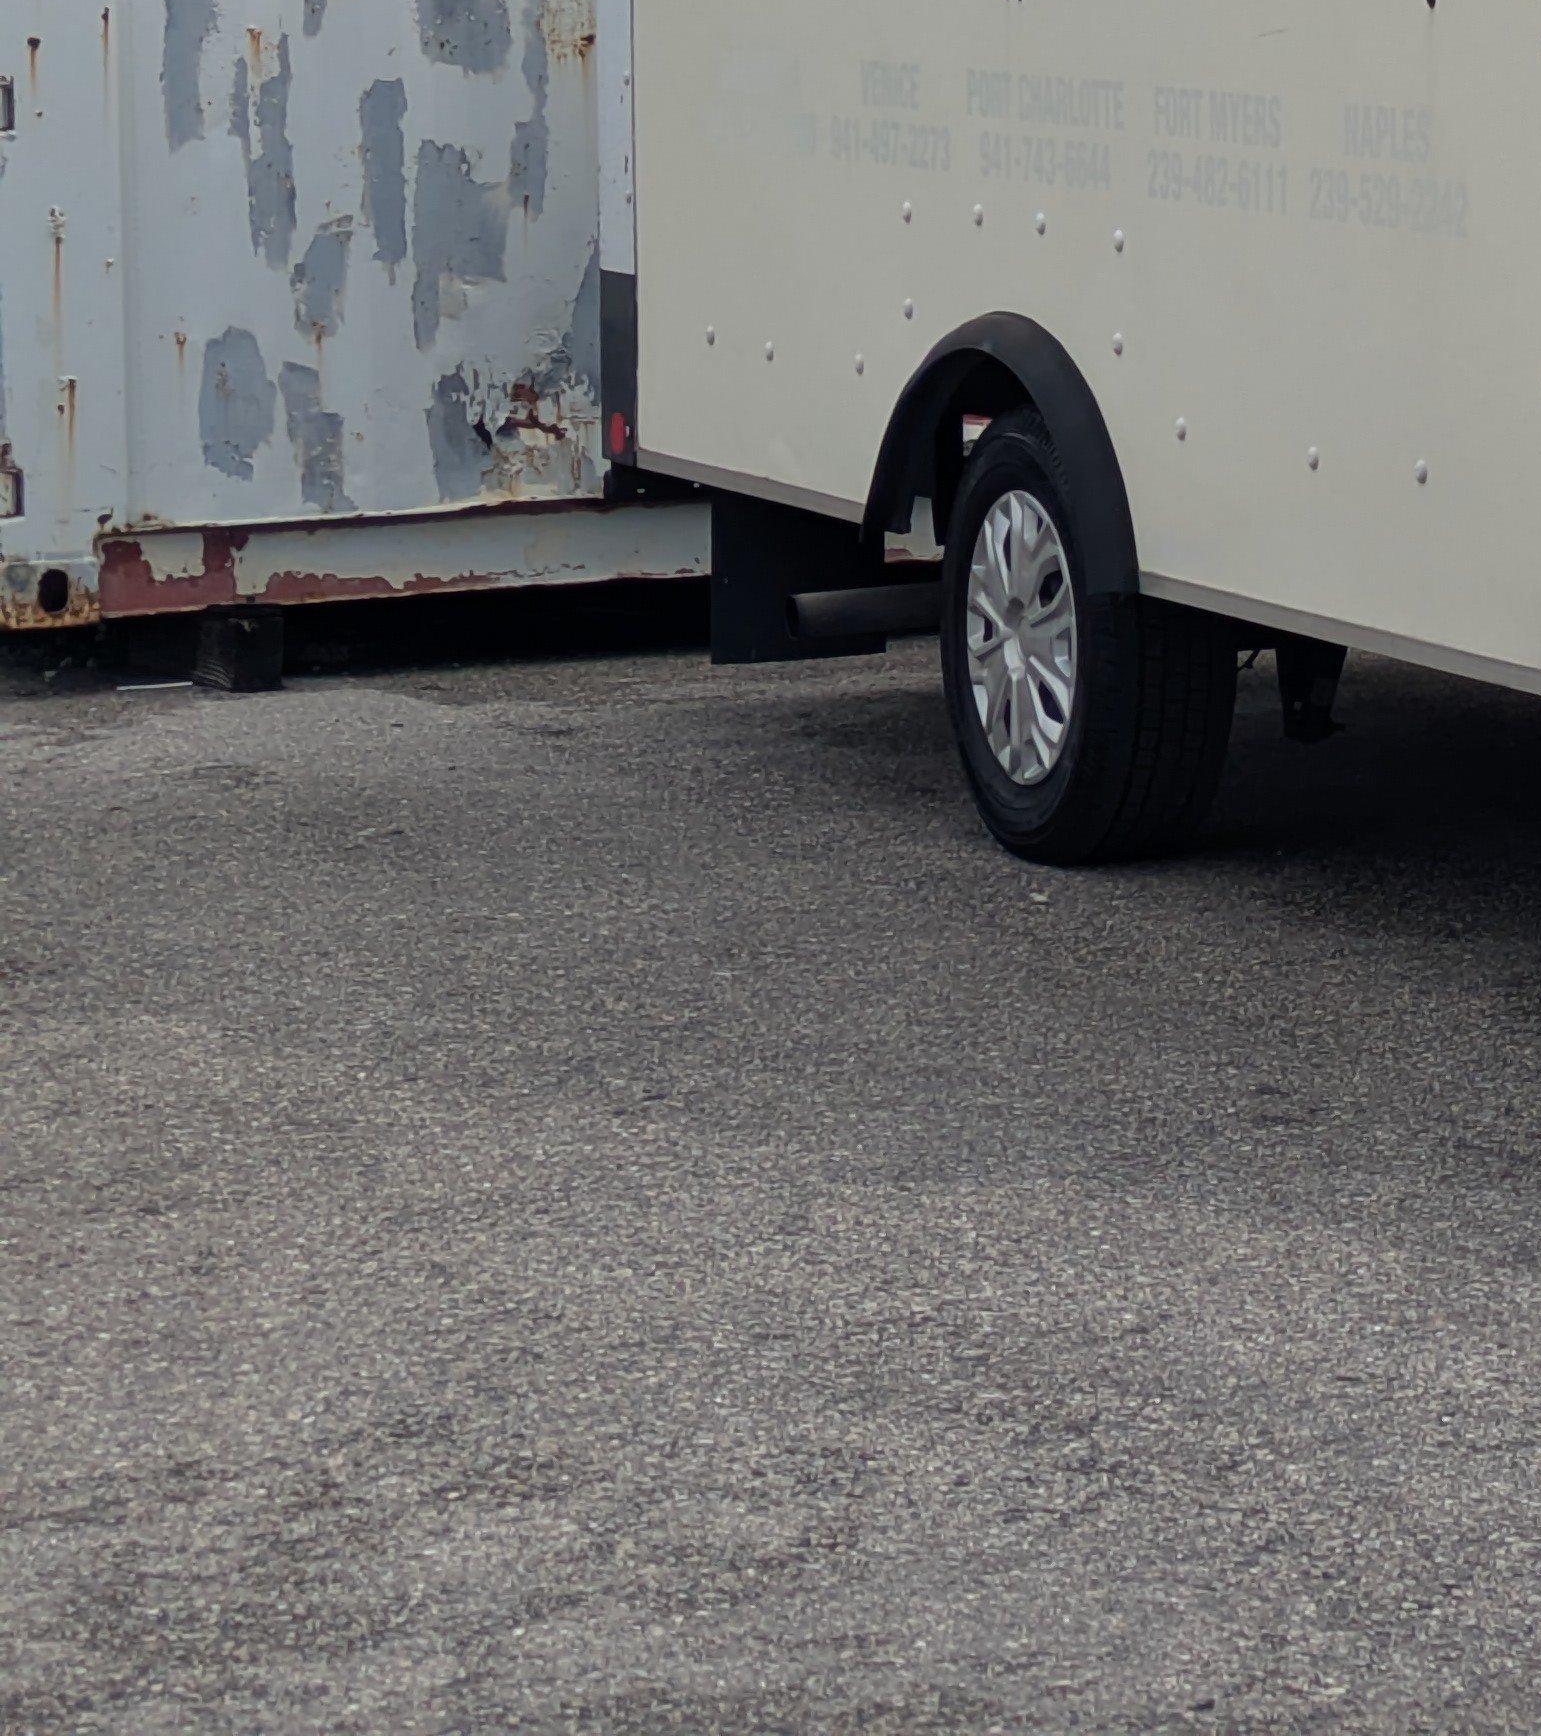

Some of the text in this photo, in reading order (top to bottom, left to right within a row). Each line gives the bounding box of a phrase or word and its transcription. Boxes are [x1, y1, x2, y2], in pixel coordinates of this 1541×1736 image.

[860, 60, 920, 110] VENICE
[966, 68, 1125, 130] PORT CHARLOTTE
[1154, 86, 1281, 149] FORT MYERS
[1343, 103, 1432, 163] NAPLES
[1147, 148, 1288, 216] 239-482-6111
